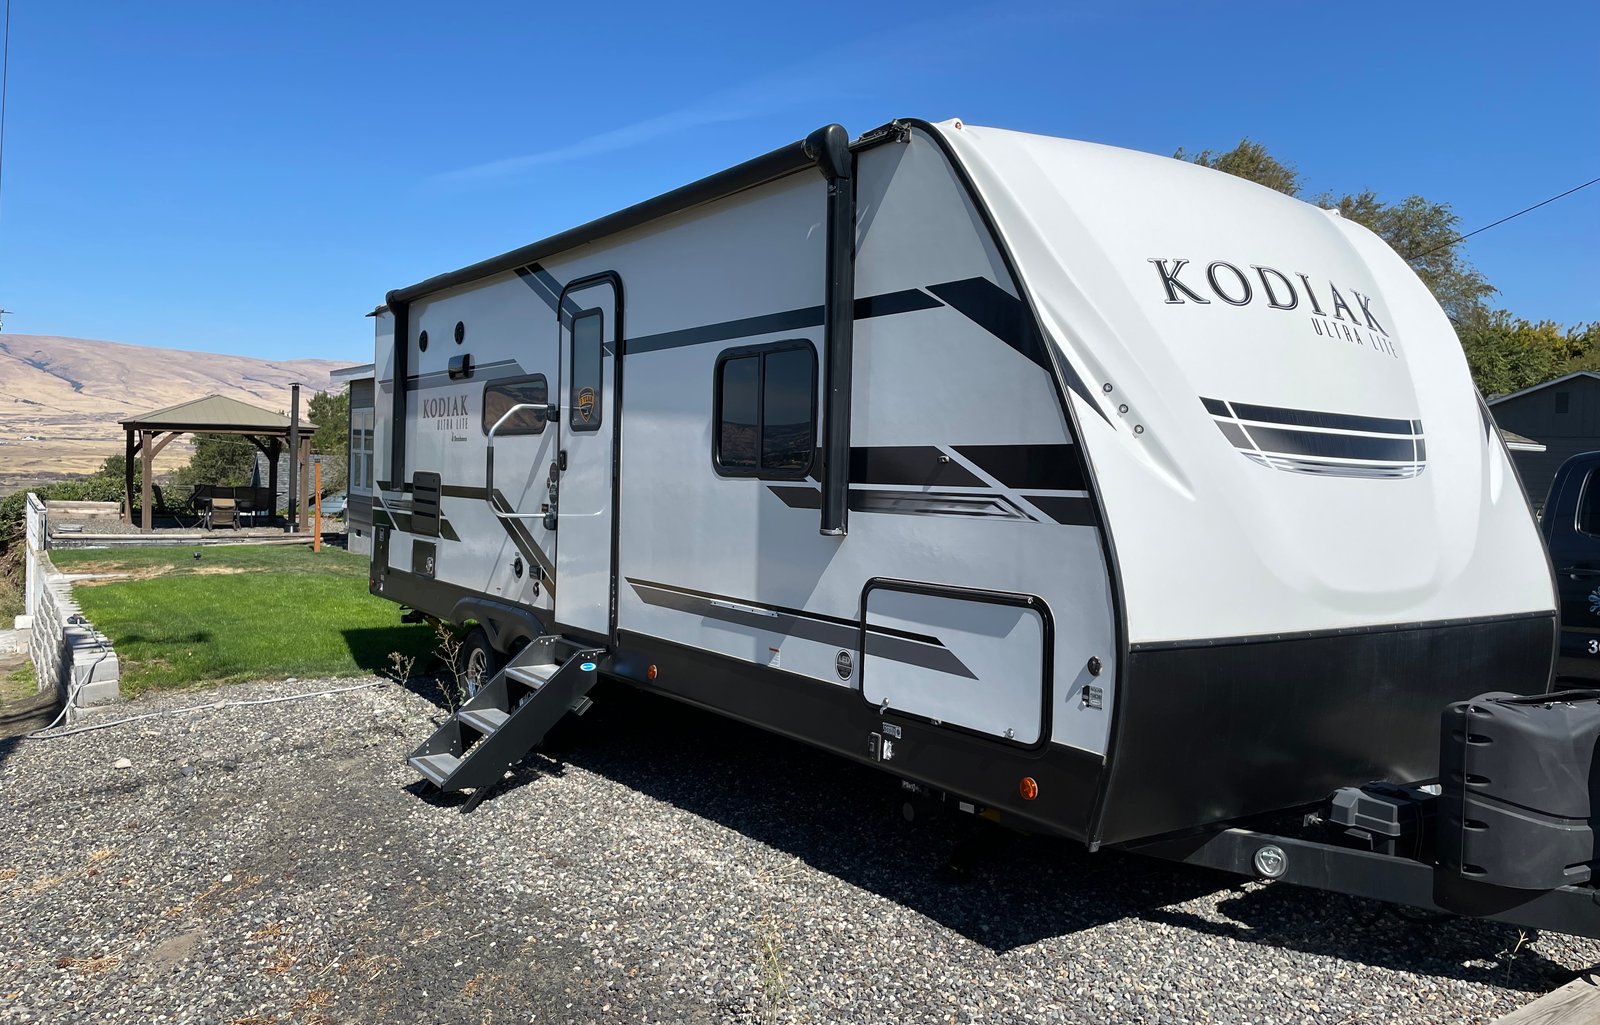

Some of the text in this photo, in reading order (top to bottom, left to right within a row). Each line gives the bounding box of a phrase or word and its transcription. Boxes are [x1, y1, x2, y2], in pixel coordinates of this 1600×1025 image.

[1147, 257, 1390, 337] KODIAK
[1311, 317, 1398, 358] ULTRA LITE
[422, 394, 469, 419] KODIAK
[437, 417, 468, 431] ULTRA LITE
[1588, 639, 1600, 654] 3
[838, 655, 851, 665] LED
